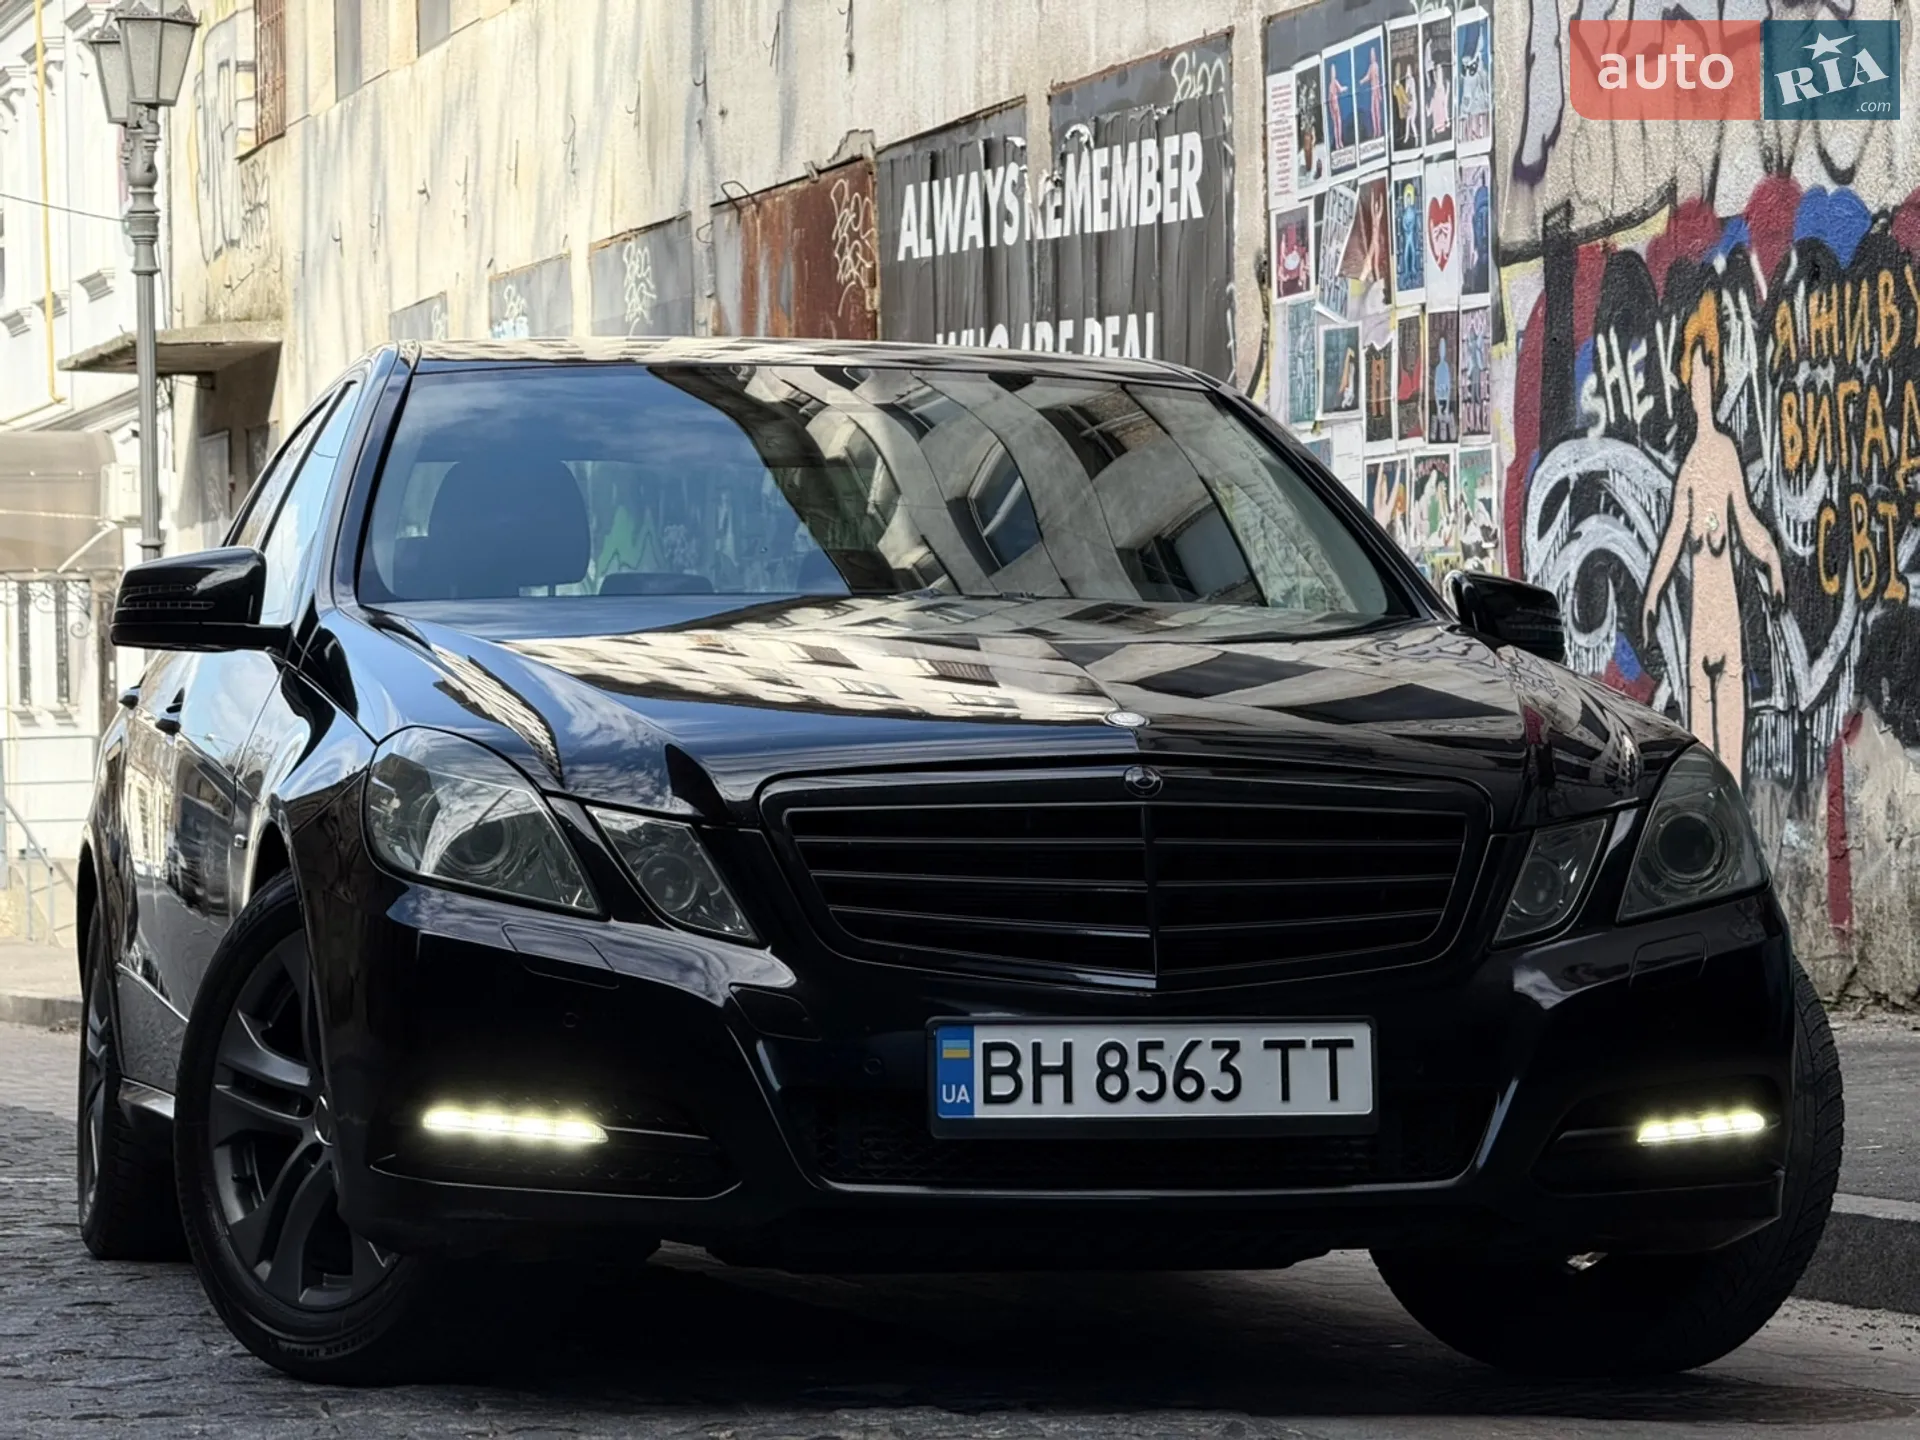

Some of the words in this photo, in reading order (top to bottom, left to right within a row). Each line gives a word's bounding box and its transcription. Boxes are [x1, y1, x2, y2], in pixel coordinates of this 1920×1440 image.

[896, 162, 1019, 262] ALWAYS
[1023, 130, 1205, 242] REMEMBER
[1817, 492, 1920, 601] СВІ
[941, 1084, 970, 1104] UA
[981, 1040, 1074, 1105] BH
[1095, 1039, 1243, 1104] 8563
[1262, 1038, 1354, 1103] TT
